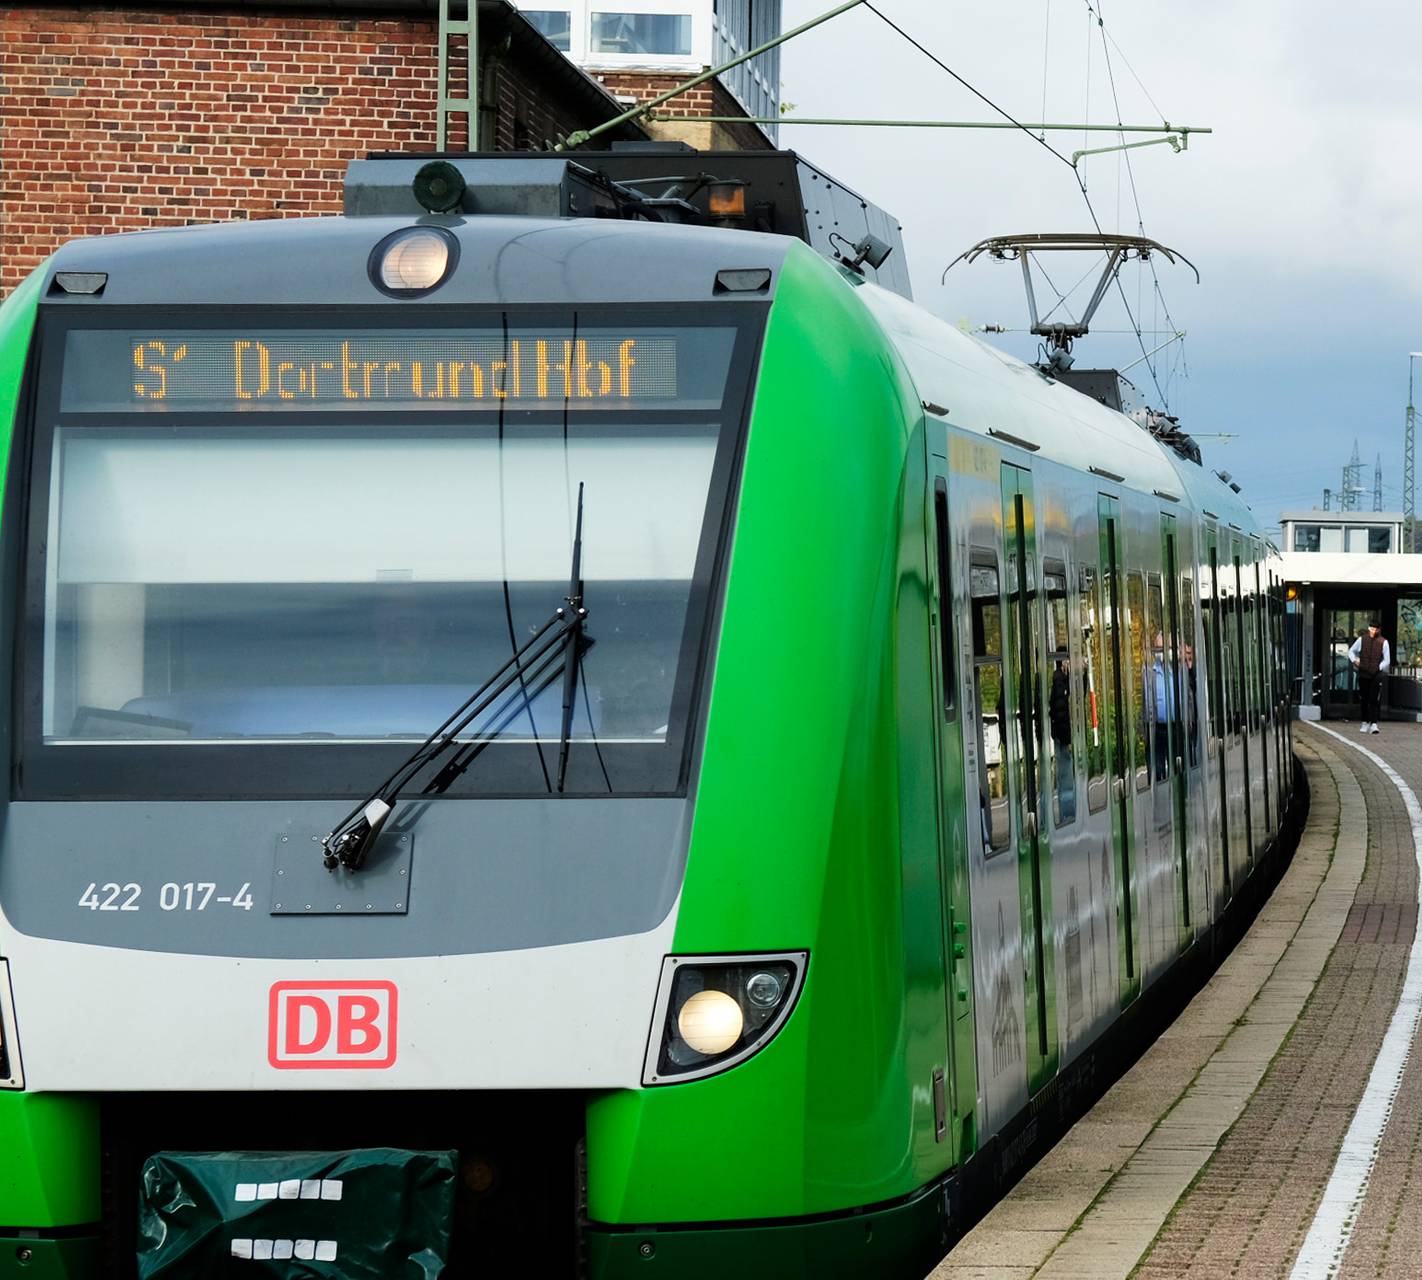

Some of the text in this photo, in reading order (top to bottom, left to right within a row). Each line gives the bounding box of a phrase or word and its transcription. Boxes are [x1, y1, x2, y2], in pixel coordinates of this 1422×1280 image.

[537, 340, 636, 398] Hbf
[78, 882, 254, 911] 422 017-4
[284, 995, 383, 1055] DB
